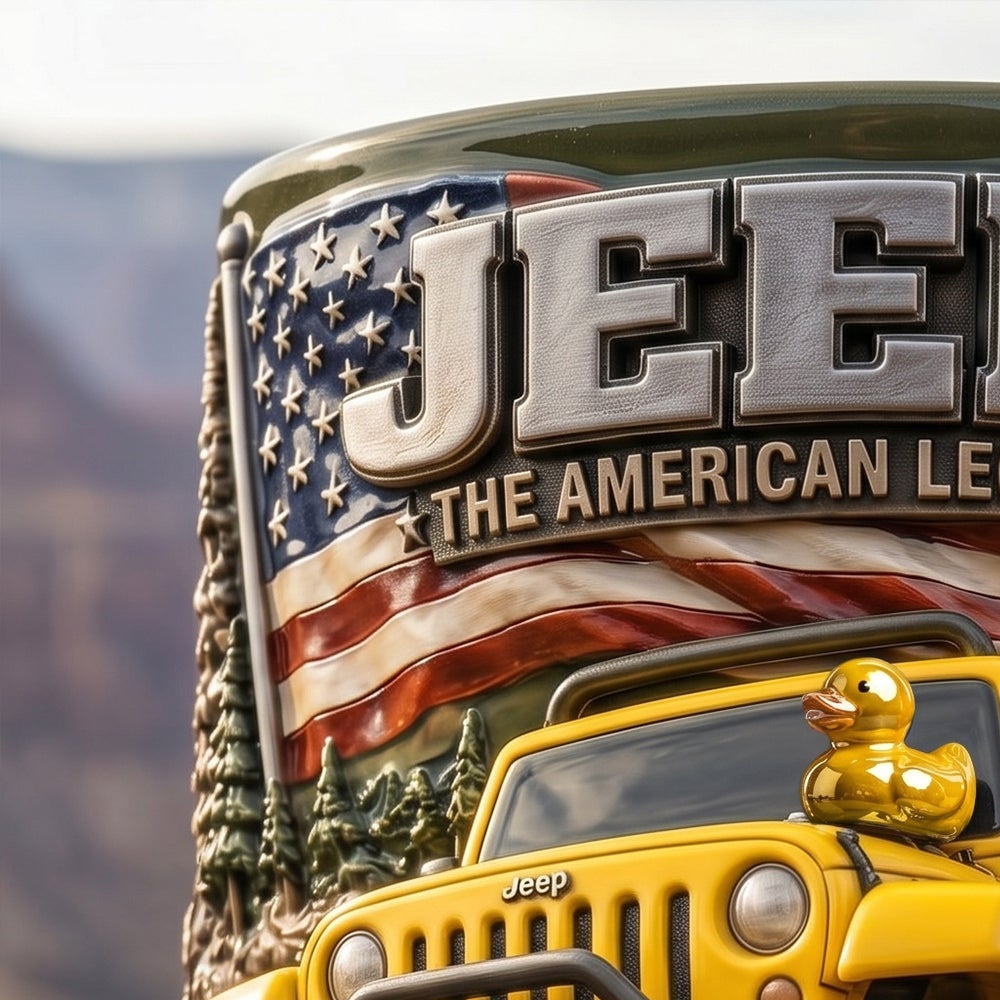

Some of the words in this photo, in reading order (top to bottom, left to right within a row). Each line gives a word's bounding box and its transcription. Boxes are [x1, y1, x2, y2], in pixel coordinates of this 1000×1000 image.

[431, 470, 540, 544] THE
[557, 437, 892, 524] AMERICAN
[502, 870, 569, 901] Jeep
